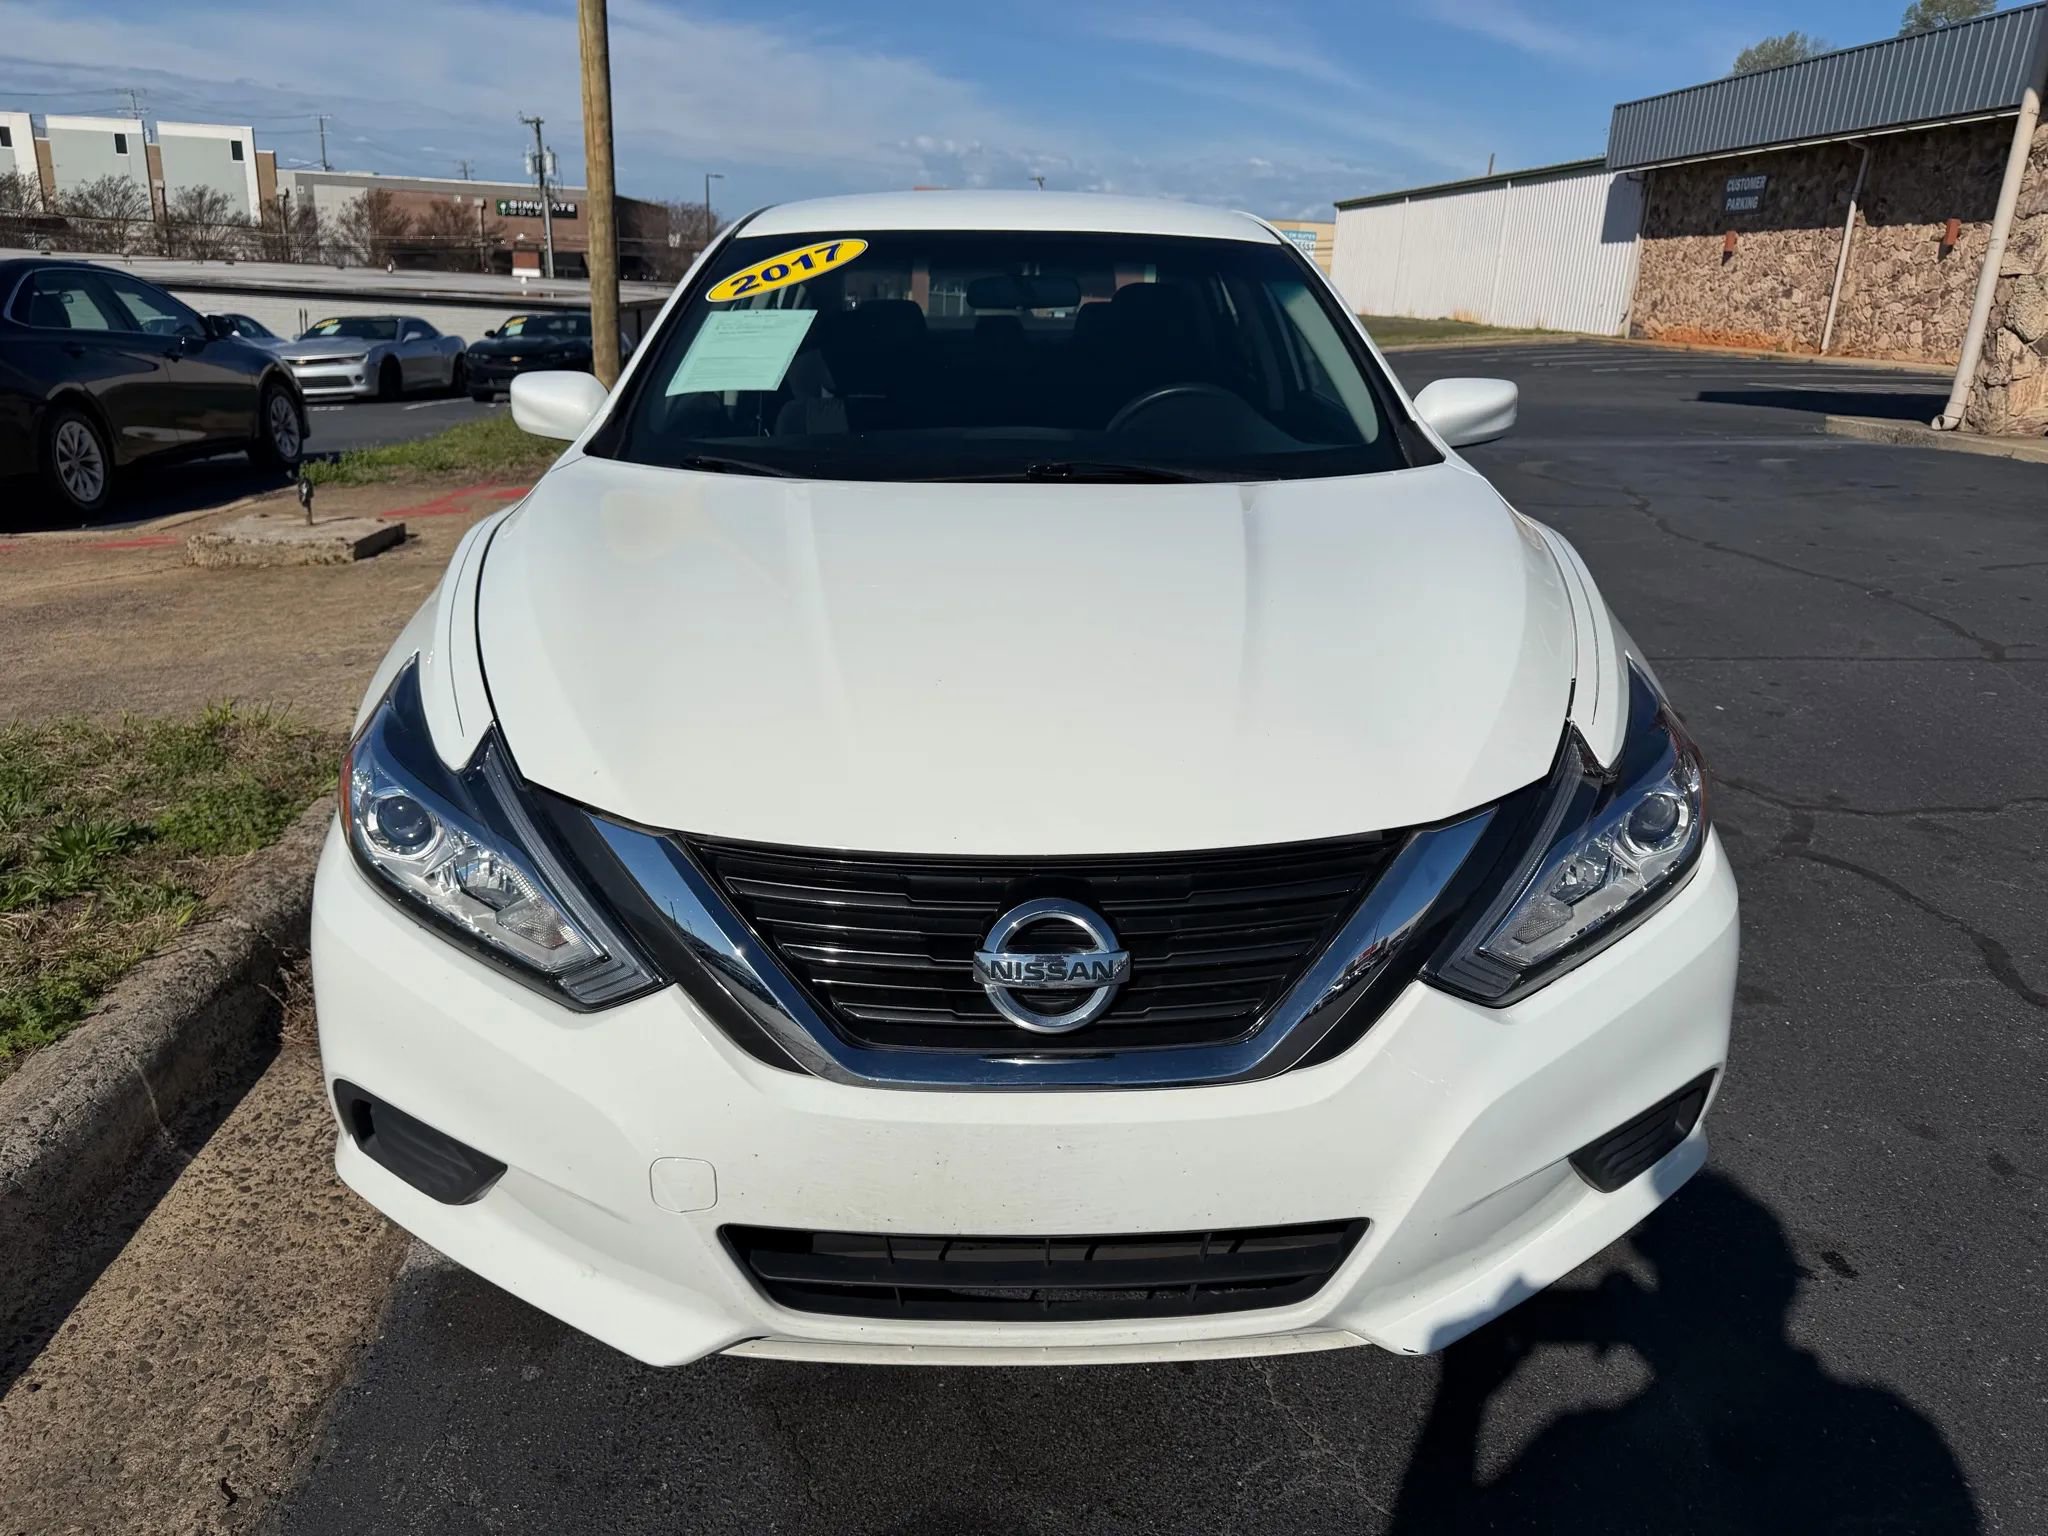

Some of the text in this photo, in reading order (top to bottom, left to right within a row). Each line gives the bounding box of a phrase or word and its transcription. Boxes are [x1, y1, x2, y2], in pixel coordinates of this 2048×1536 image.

[1726, 175, 1767, 192] CUSTOMER
[509, 200, 576, 212] SIMUATE
[1725, 195, 1759, 211] PARKING
[730, 243, 843, 296] 2017
[990, 960, 1113, 980] NISSAN
